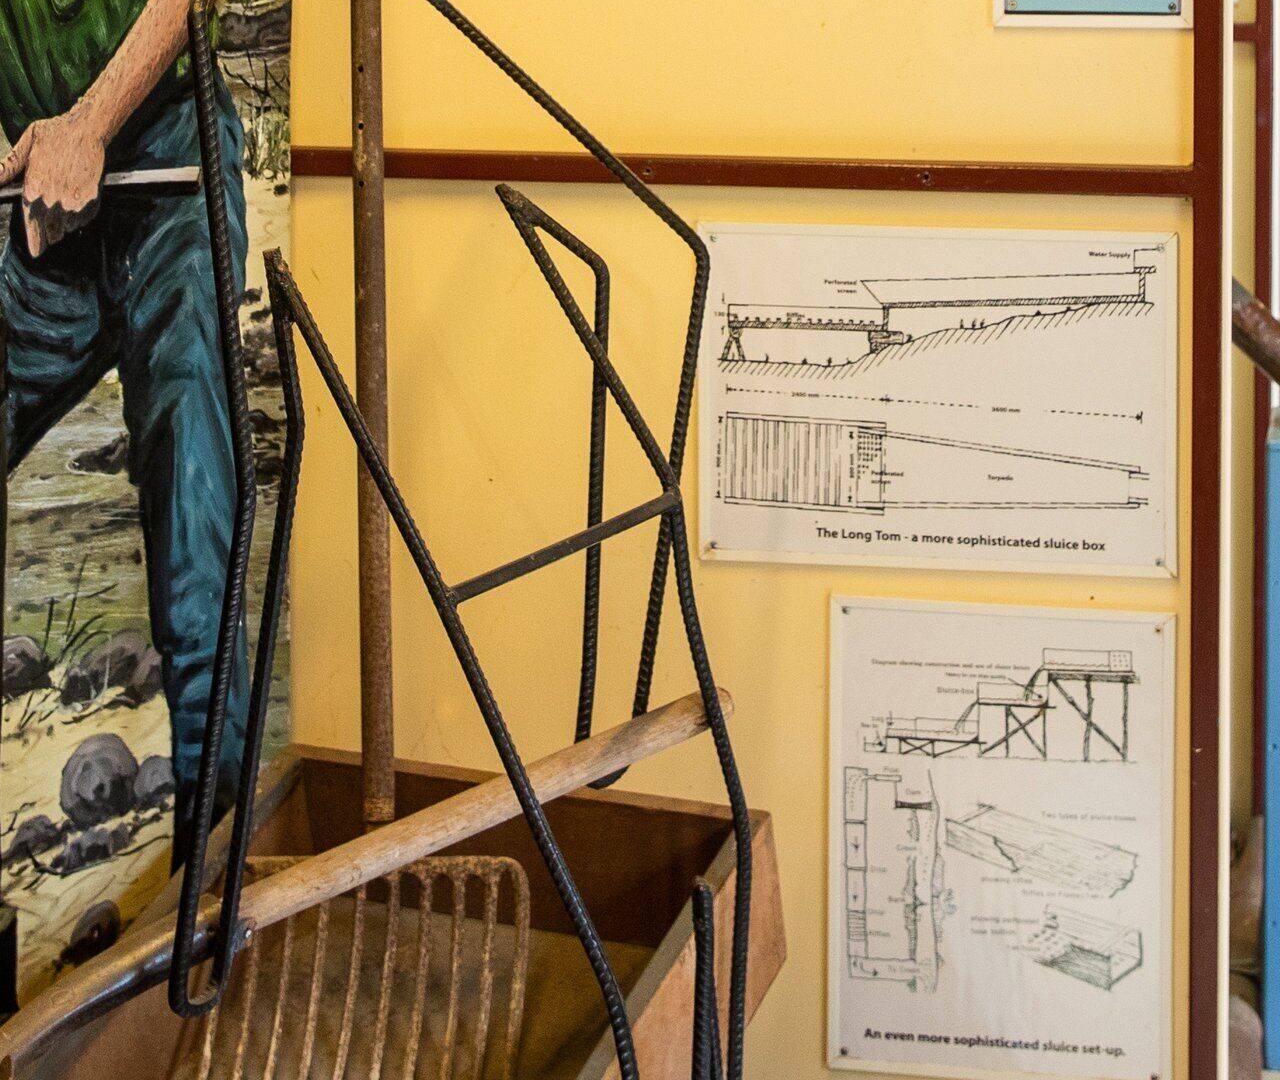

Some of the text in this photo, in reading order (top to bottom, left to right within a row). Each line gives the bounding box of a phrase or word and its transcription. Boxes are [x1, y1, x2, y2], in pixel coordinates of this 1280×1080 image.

[815, 527, 1105, 551] The Long Tom a more sophisticated sluice box
[863, 1027, 1125, 1057] An even more sophisticated sluice set-up.
